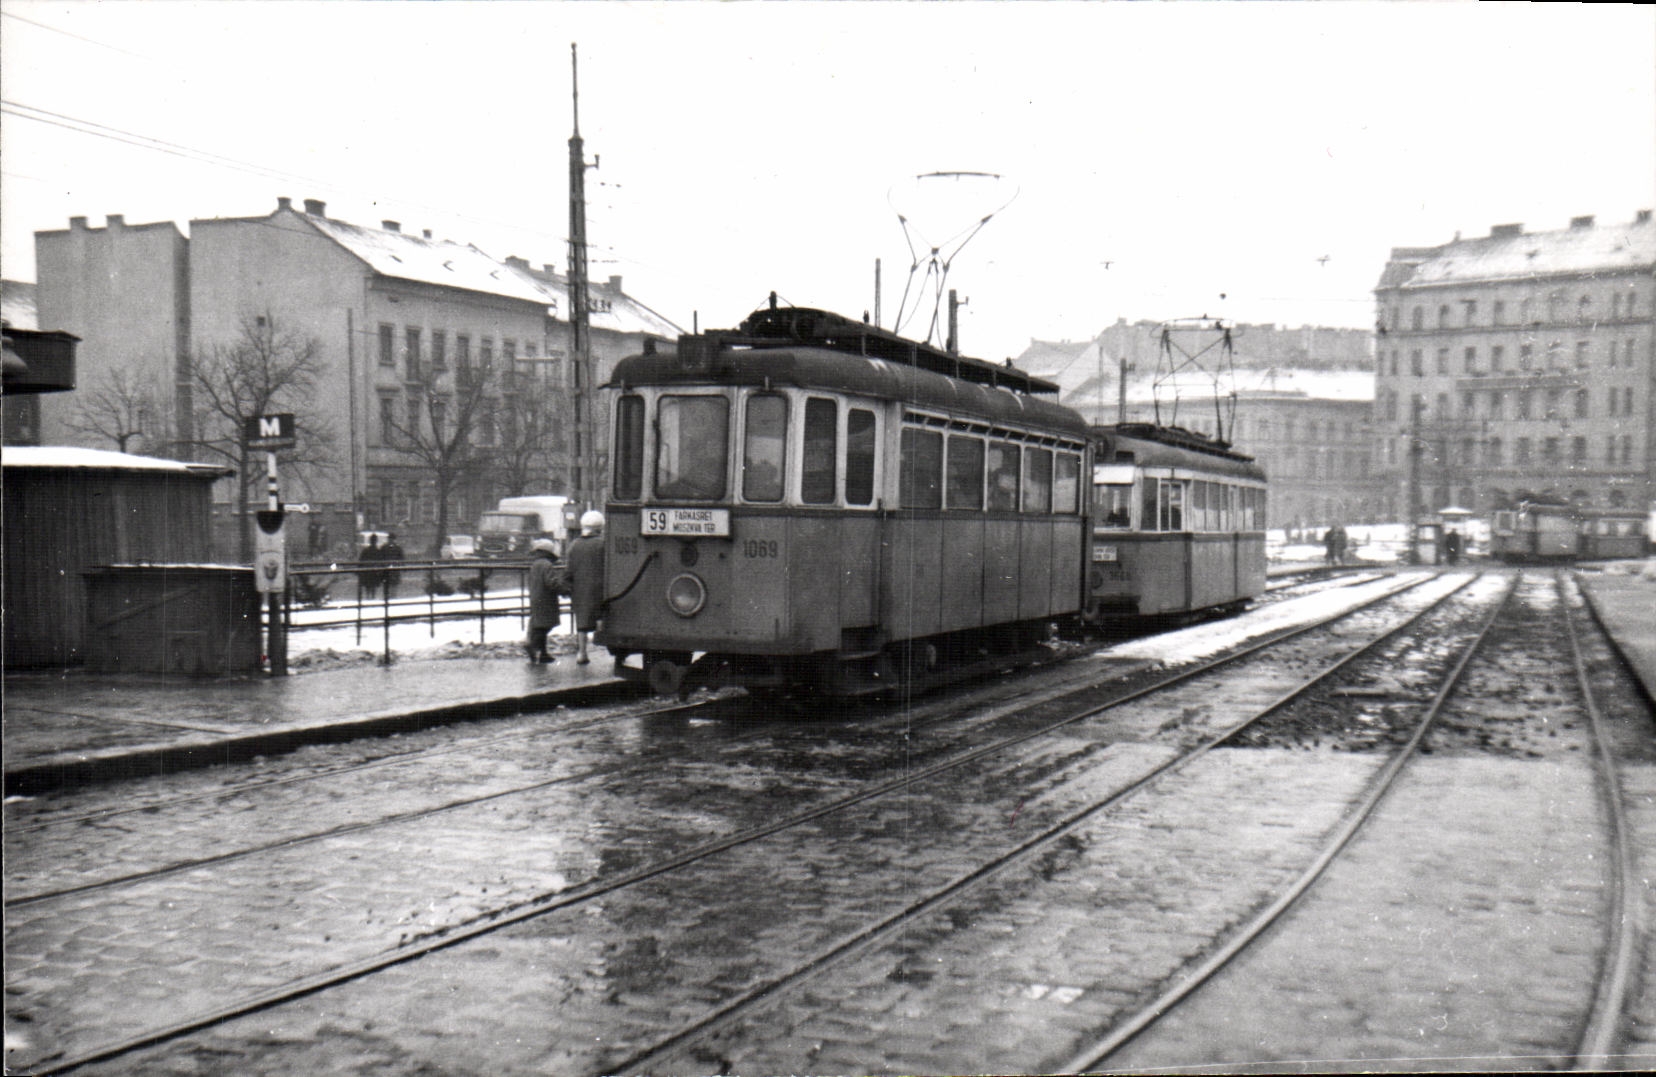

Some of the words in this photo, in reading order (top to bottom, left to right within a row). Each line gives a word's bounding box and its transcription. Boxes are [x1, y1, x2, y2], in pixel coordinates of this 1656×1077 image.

[260, 417, 281, 437] M
[649, 511, 667, 531] 59
[743, 540, 779, 558] 1069
